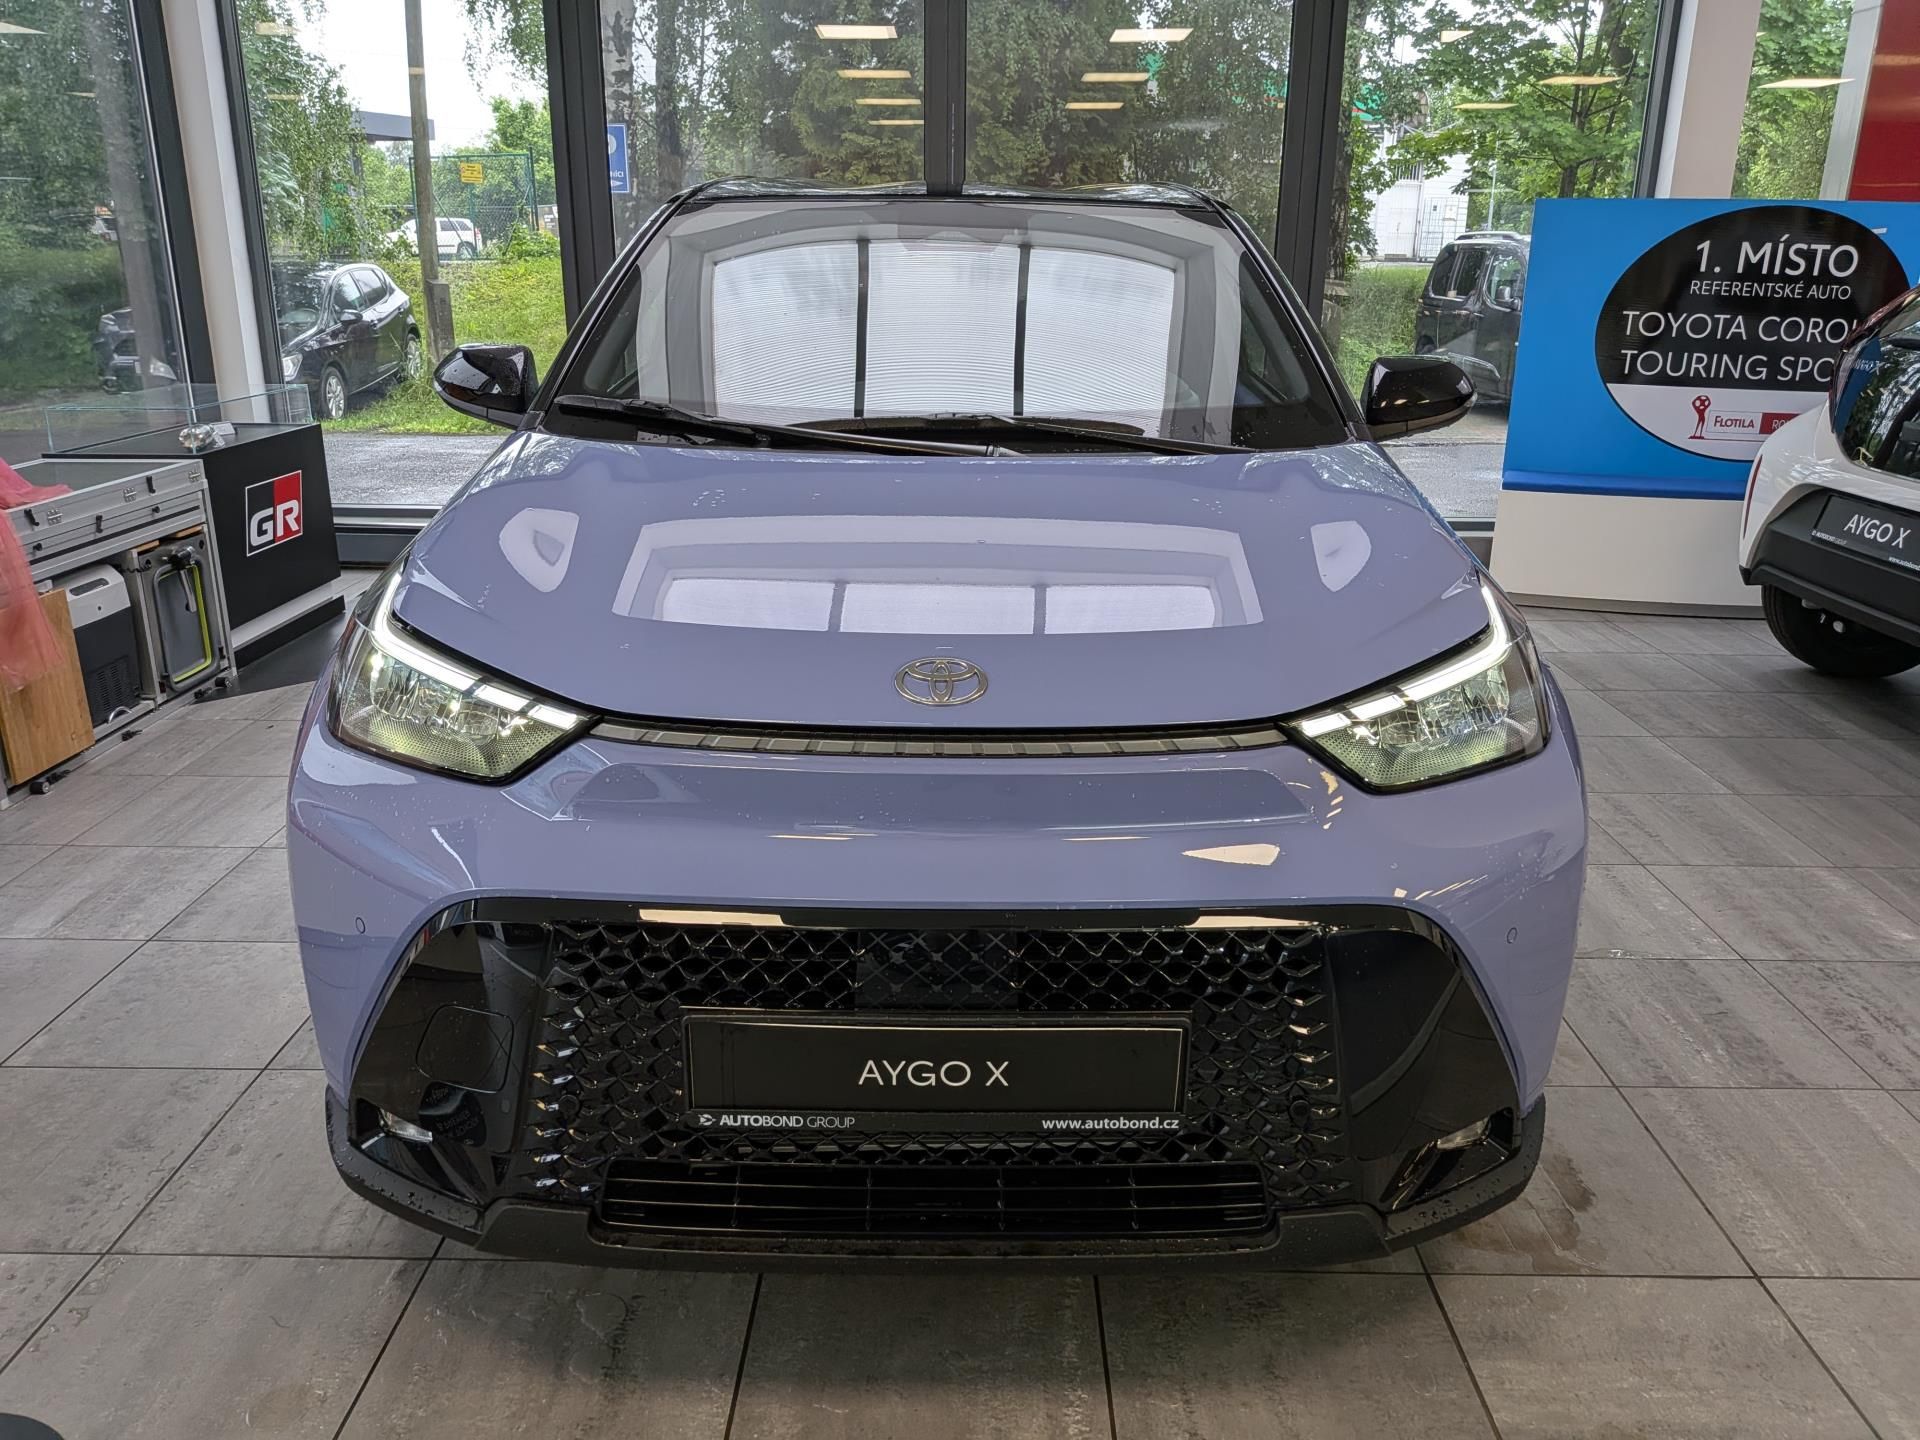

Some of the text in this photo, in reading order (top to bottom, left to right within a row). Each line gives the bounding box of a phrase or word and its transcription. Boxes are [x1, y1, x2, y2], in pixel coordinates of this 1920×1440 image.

[1696, 233, 1859, 278] 1. MÍSTO
[1689, 280, 1851, 300] REFERENTSKÉ AUTO
[1622, 310, 1747, 340] TOYOTA
[1620, 349, 1768, 380] TOURING
[251, 500, 299, 546] GR
[1843, 513, 1894, 543] AYGO
[1891, 527, 1912, 549] X
[858, 1059, 1010, 1087] AYGO X
[719, 1114, 856, 1129] AUTOBOND GROUP
[1041, 1116, 1180, 1130] www.autobond.cz
